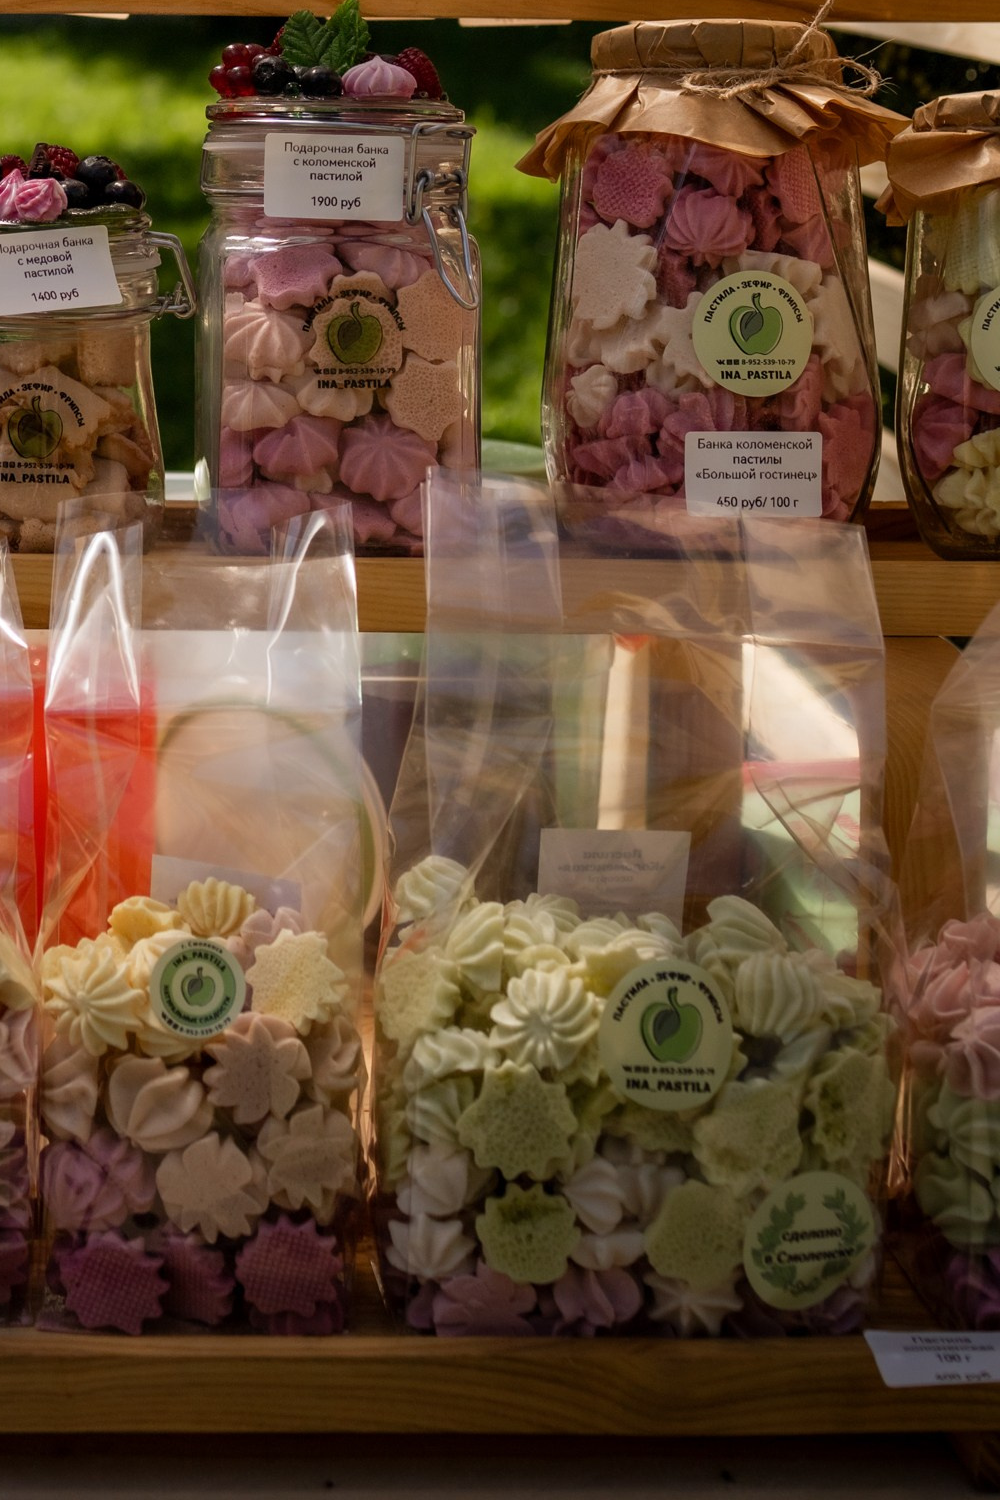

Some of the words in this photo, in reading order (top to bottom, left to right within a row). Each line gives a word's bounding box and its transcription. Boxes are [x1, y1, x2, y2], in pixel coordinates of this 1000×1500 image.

[284, 142, 354, 155] Подарочная
[357, 143, 389, 155] банка
[293, 158, 299, 166] с
[302, 157, 376, 168] коломенской
[310, 171, 363, 181] пастилой
[311, 196, 338, 207] 1900
[340, 197, 361, 209] руб
[62, 237, 93, 248] банка
[17, 258, 24, 266] с
[26, 251, 73, 264] медовой
[24, 264, 74, 279] пастилой
[31, 290, 58, 302] 1400
[60, 288, 79, 301] руб
[704, 286, 736, 323] ПАСТИЛА
[741, 280, 773, 289] ЗЕФИР
[777, 288, 803, 323] ФРИПСЫ
[302, 295, 335, 332] ПАСТИЛА
[340, 289, 372, 297] ЗЕФИР
[378, 296, 407, 332] ФРИПСЫ
[982, 298, 1000, 331] ПАСТИ
[721, 370, 792, 381] INA_PASTILA
[317, 379, 392, 390] INA_PASTILA
[21, 383, 53, 392] ЗЕФИР
[59, 391, 85, 428] ФРИПСЫ
[697, 438, 733, 449] Банка
[736, 438, 813, 450] коломенской
[733, 456, 782, 465] пастилы
[695, 468, 756, 480] «Большой
[760, 470, 818, 482] гостинец»
[716, 496, 738, 508] 450
[741, 496, 768, 510] руб/
[770, 497, 790, 508] 100
[793, 499, 799, 507] г
[613, 978, 650, 1022] ПАСТИЛА
[626, 1078, 712, 1093] INA_PASTILA
[936, 1353, 961, 1363] 100
